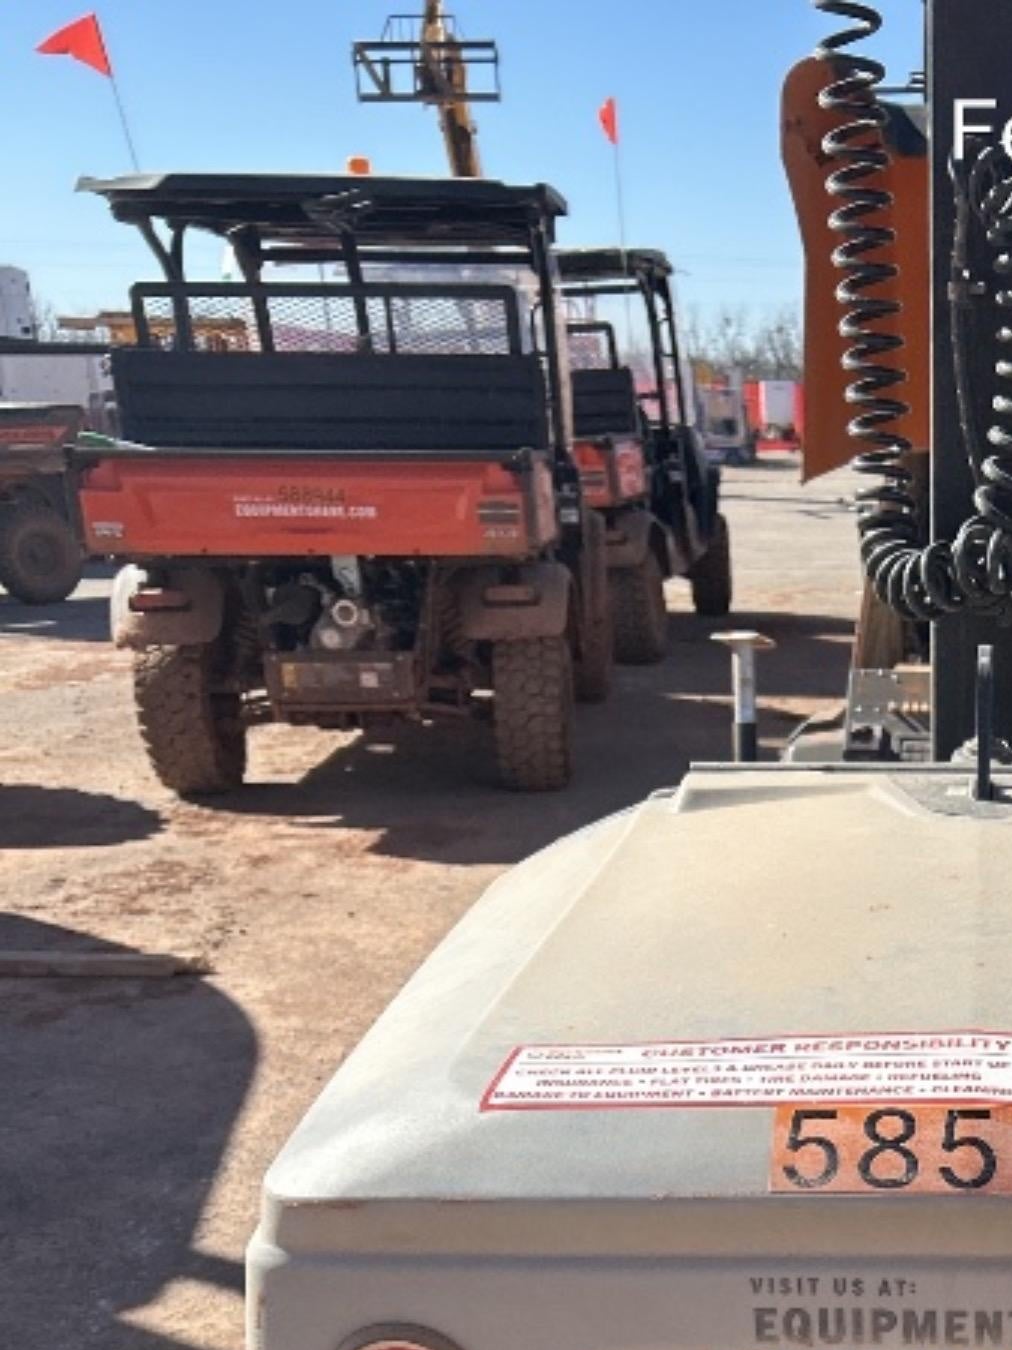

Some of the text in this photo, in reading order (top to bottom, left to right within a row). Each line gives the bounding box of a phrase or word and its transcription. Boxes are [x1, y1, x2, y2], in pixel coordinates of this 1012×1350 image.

[641, 1037, 1012, 1058] CUSTOMER RESPONSIBILITY
[749, 1277, 917, 1298] VISIT US AT:
